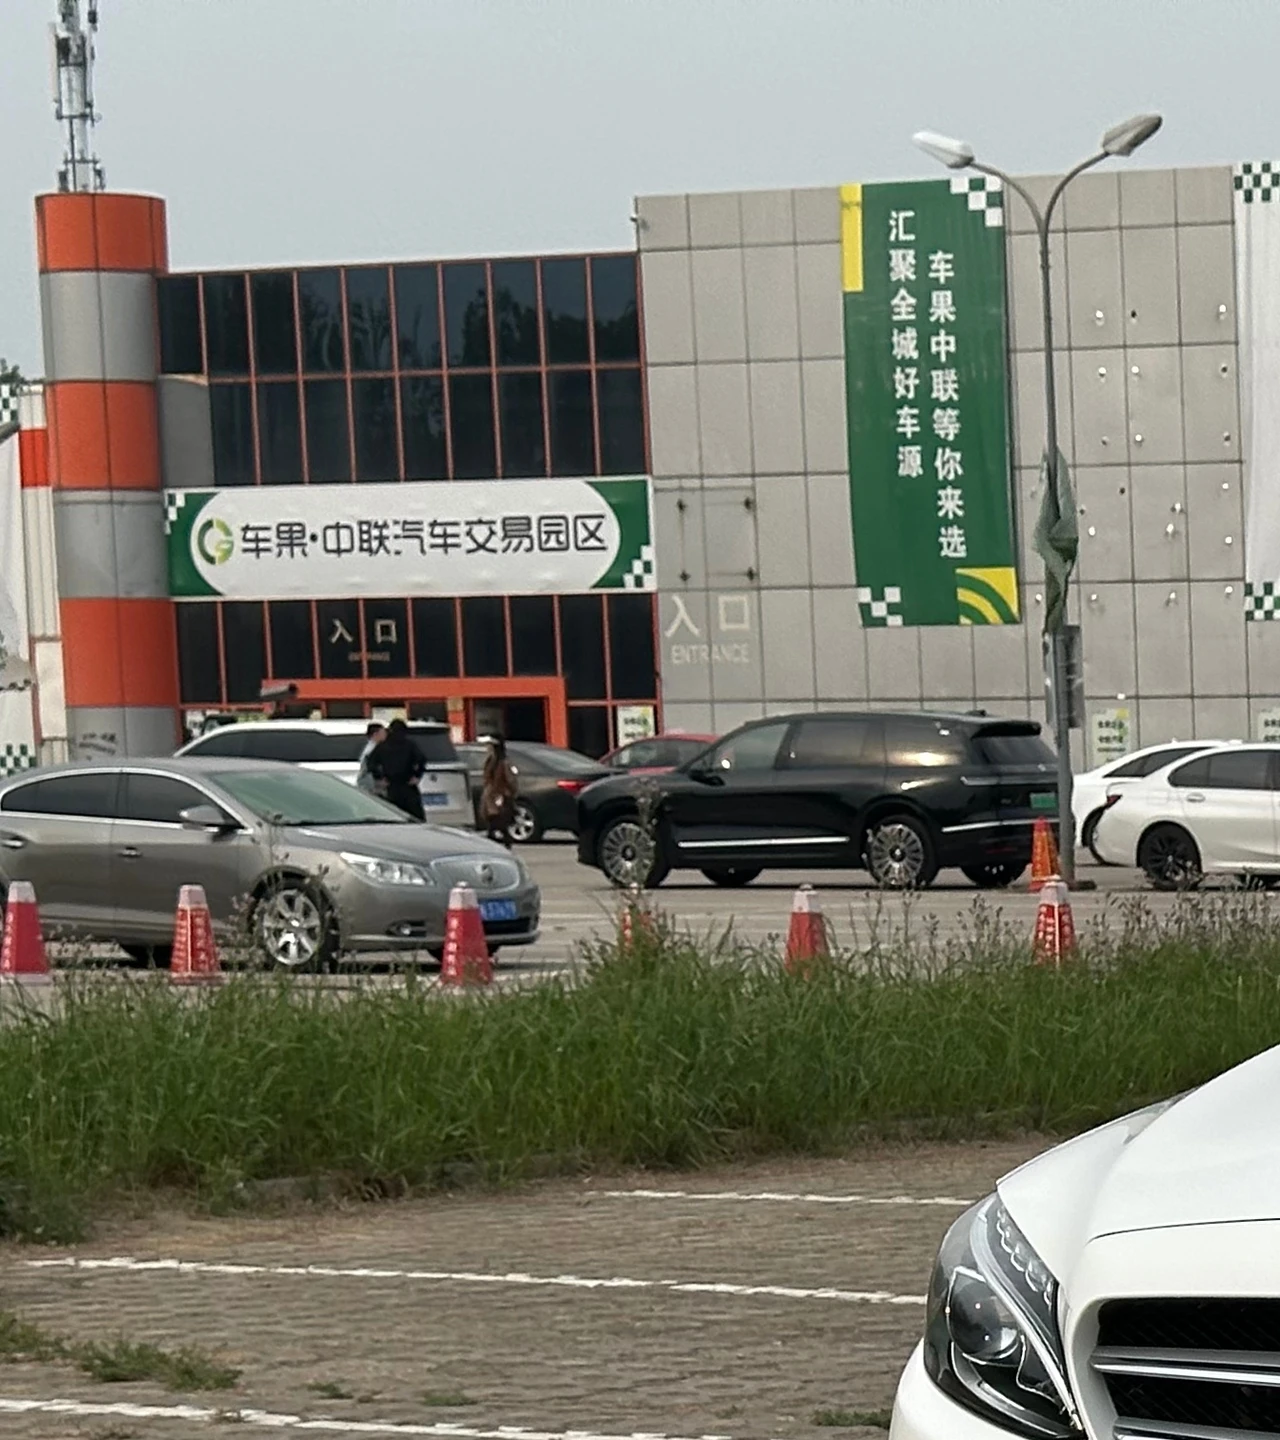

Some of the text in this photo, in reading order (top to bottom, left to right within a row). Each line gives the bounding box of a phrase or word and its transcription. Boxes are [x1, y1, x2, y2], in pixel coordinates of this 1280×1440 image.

[889, 210, 923, 478] 汇聚全城好车源
[928, 250, 967, 558] 车果中联等你来选
[240, 515, 608, 559] 车果·中联汽车交易园区
[330, 619, 397, 643] 入口
[664, 596, 750, 638] 入口
